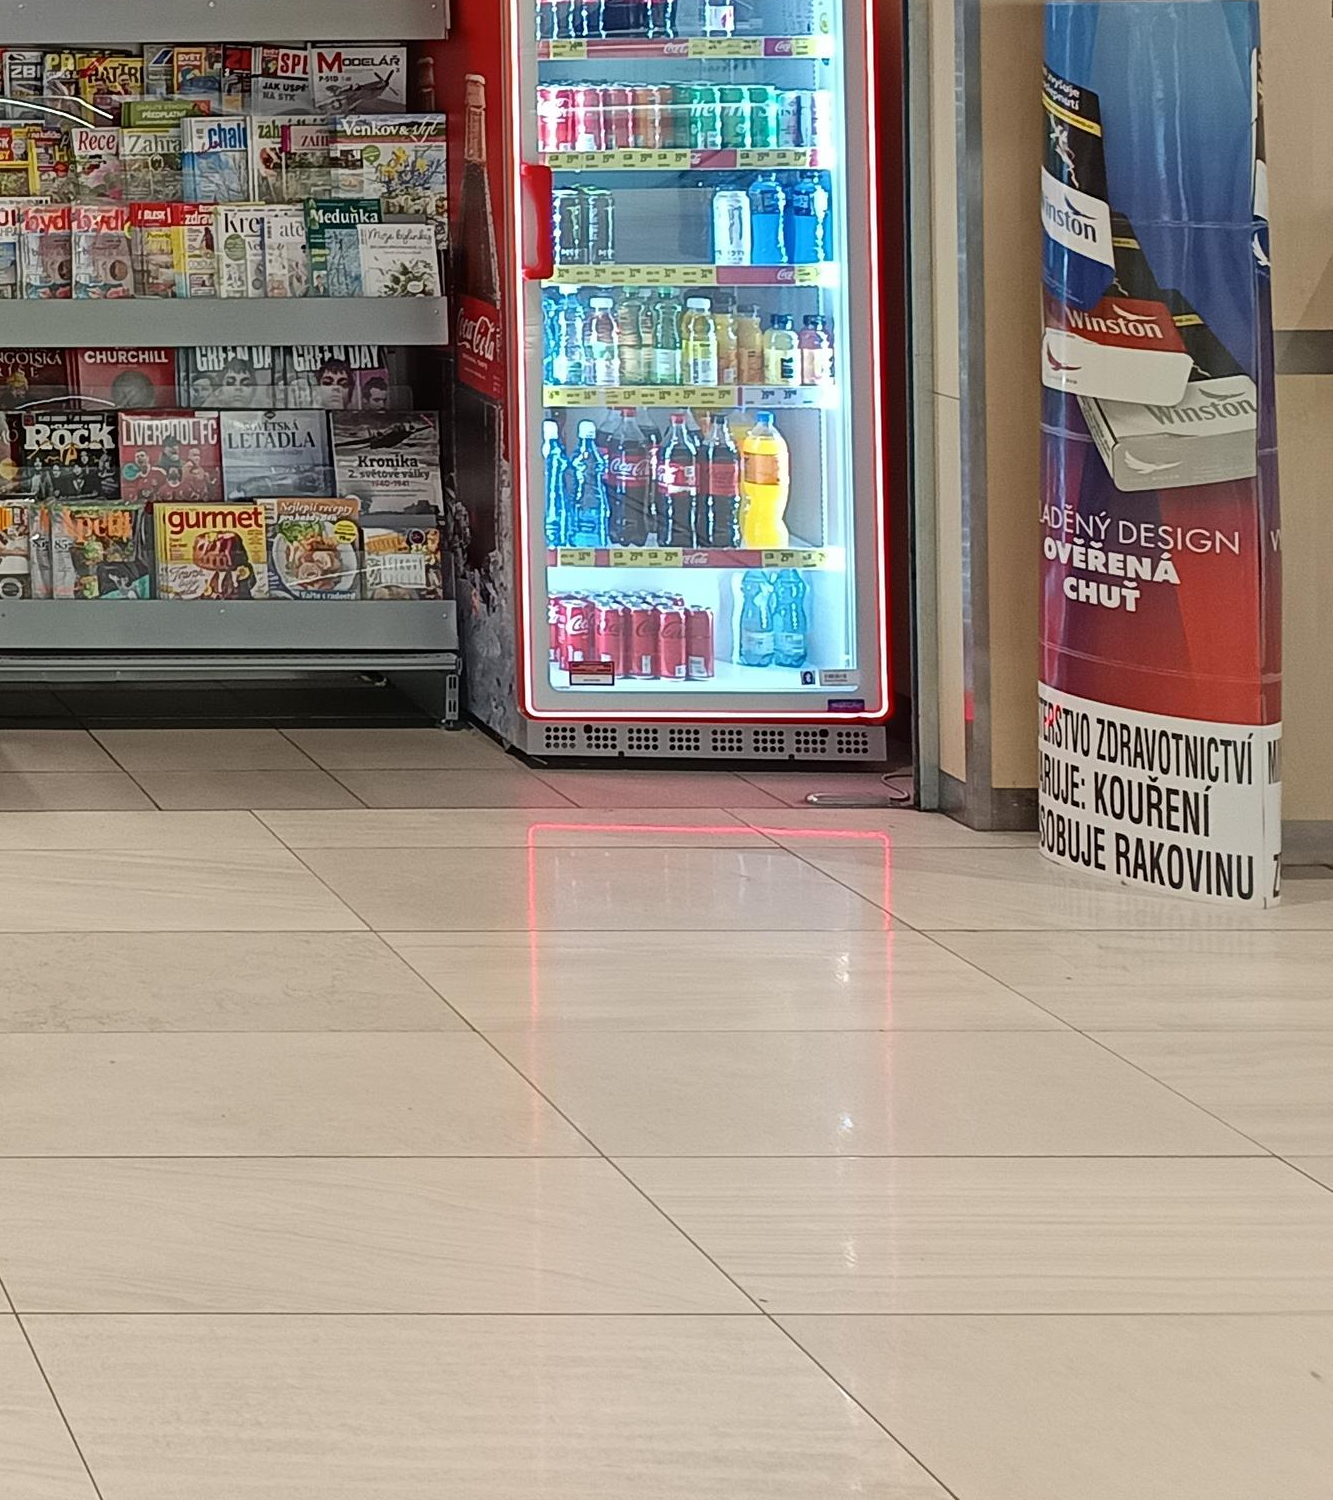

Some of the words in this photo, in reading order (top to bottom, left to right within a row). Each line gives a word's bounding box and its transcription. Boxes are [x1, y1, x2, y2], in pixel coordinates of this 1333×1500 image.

[317, 52, 400, 73] MODELÁŘ
[341, 120, 399, 136] Venkov
[316, 206, 379, 225] Meduňka
[1066, 305, 1164, 339] Winston
[84, 350, 169, 364] CHURCHILL
[1143, 399, 1257, 427] Winston
[200, 419, 218, 445] FC
[227, 430, 316, 449] LETADLA
[348, 470, 356, 478] 2.
[357, 468, 401, 478] světové
[401, 468, 430, 480] války
[358, 455, 419, 468] Kronika
[168, 507, 264, 535] gurmet
[1040, 503, 1111, 541] ADĚNÝ
[1118, 521, 1240, 556] DESIGN
[1044, 537, 1181, 584] OVĚŘENÁ
[1063, 576, 1141, 612] CHUŤ
[1097, 717, 1253, 785] ZDRAVOTNICTVÍ
[1094, 772, 1210, 838] KOUŘENÍ
[1116, 832, 1254, 900] RAKOVINU
